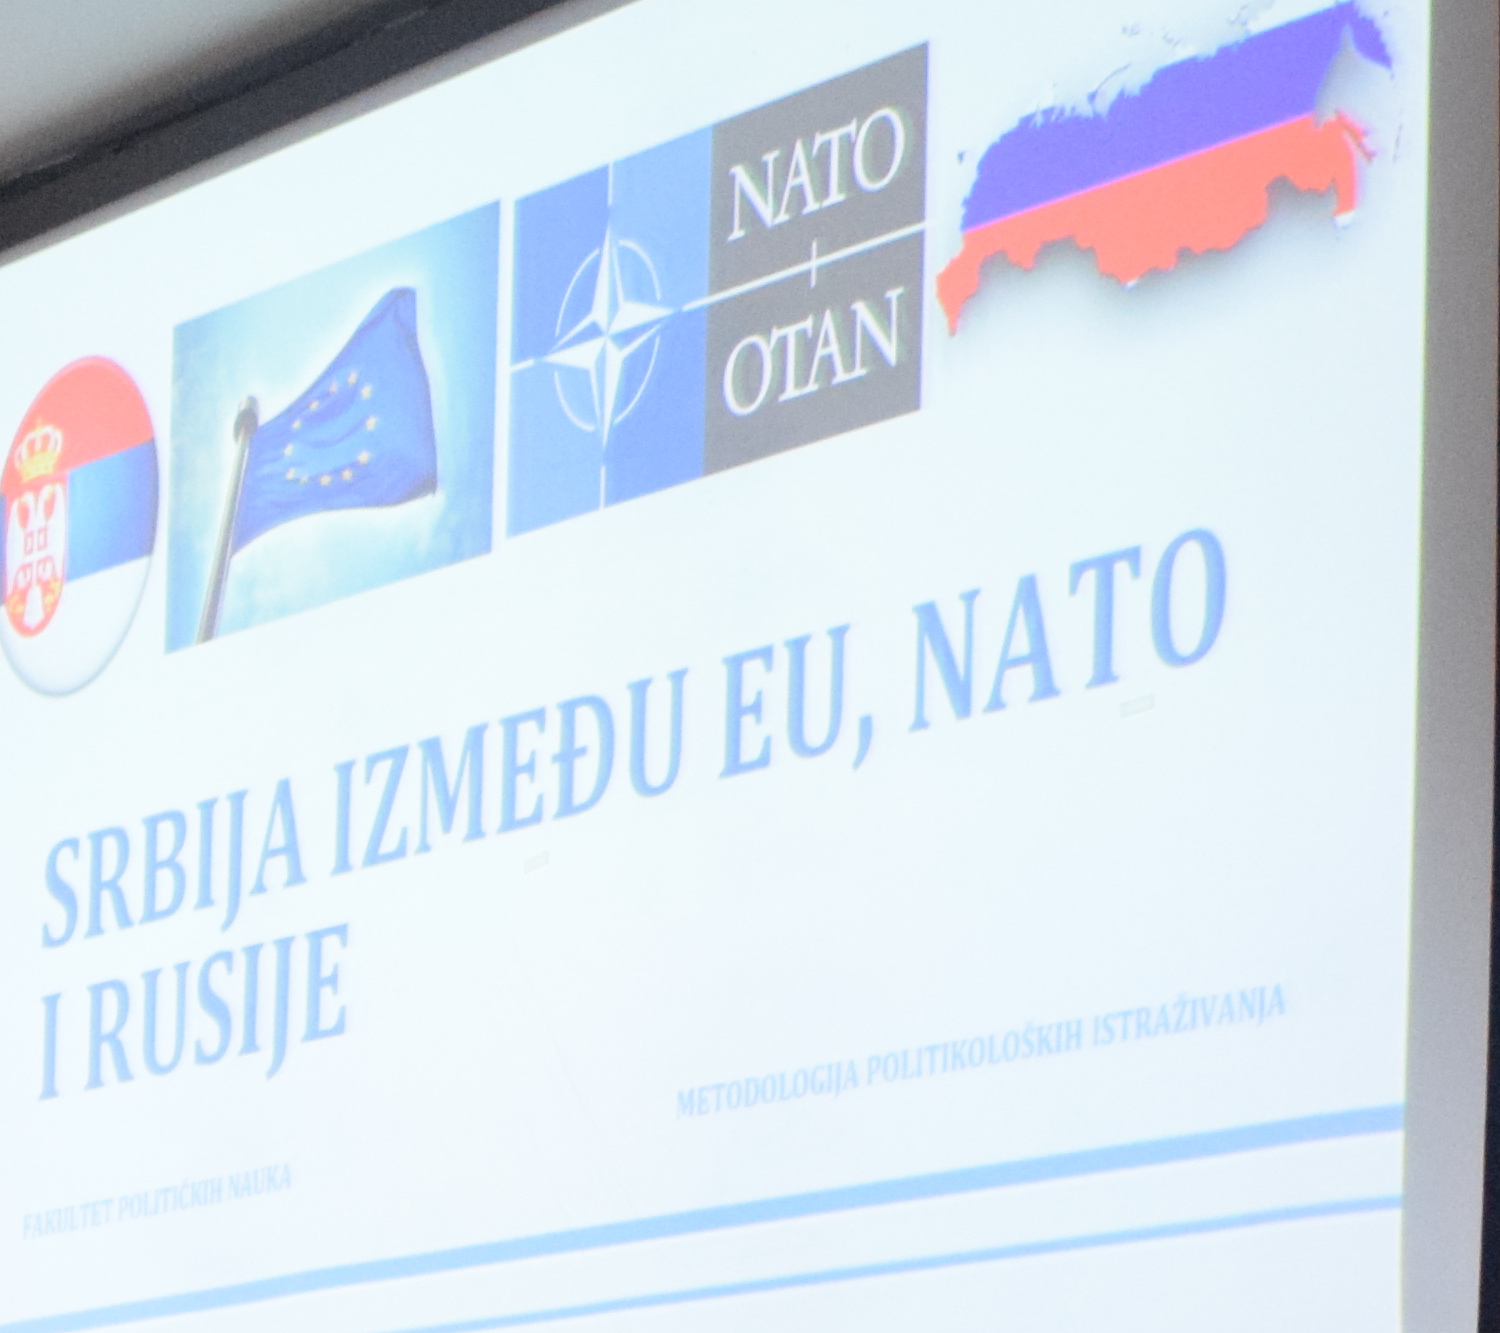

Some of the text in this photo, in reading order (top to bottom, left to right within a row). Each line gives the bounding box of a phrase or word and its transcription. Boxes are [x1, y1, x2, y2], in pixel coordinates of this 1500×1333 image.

[727, 107, 906, 243] NATO
[723, 287, 904, 417] OTAN
[42, 527, 1227, 947] SRBIJA IZMEĐU EU, NATO
[39, 923, 349, 1097] I RUSIJE
[676, 984, 1287, 1117] METODOLOGIJA POLITIKOLOŠKIH ISTRAŽIVANJA
[22, 1197, 113, 1239] FAKULTET
[228, 1162, 292, 1200] NAUKA
